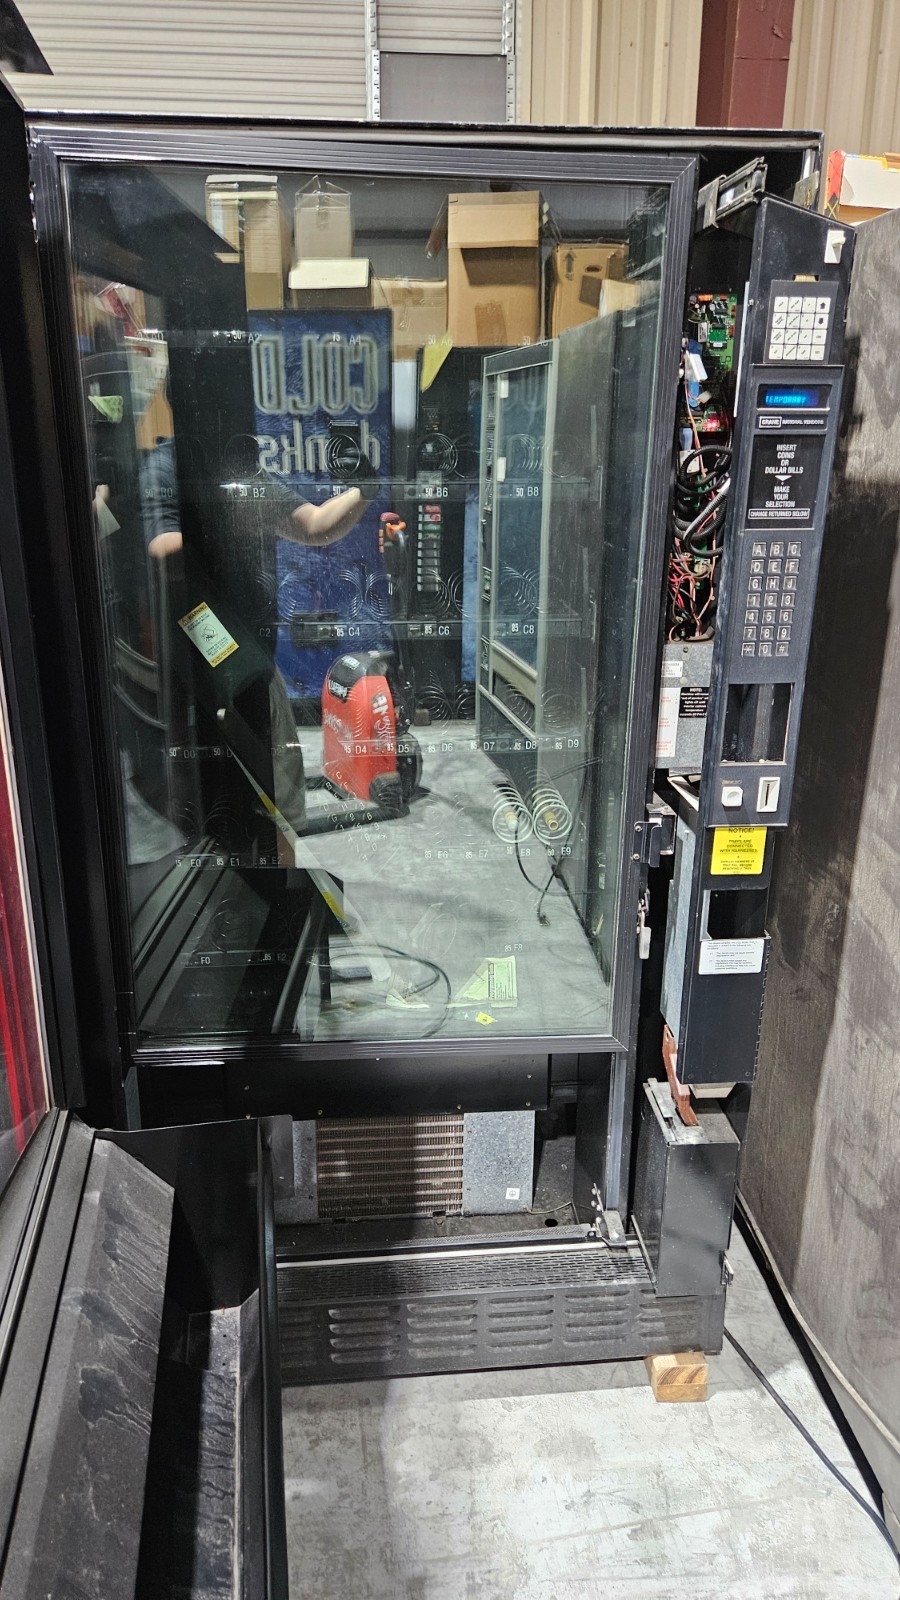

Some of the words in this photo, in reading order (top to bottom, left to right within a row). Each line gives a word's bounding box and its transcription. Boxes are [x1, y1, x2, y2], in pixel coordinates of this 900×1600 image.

[253, 487, 266, 498] B2
[436, 487, 449, 498] B6
[527, 487, 539, 497] B8
[765, 500, 796, 508] SELECTION
[259, 627, 271, 638] C2
[348, 627, 360, 637] C4
[438, 625, 450, 636] C6
[523, 624, 535, 635] C8
[442, 743, 453, 752] D6
[484, 742, 495, 750] D7
[525, 741, 537, 749] D8
[567, 739, 579, 748] D9
[355, 745, 367, 755] D4
[398, 744, 410, 754] D5
[520, 848, 531, 857] E8
[230, 858, 240, 866] E1
[200, 956, 211, 965] F0
